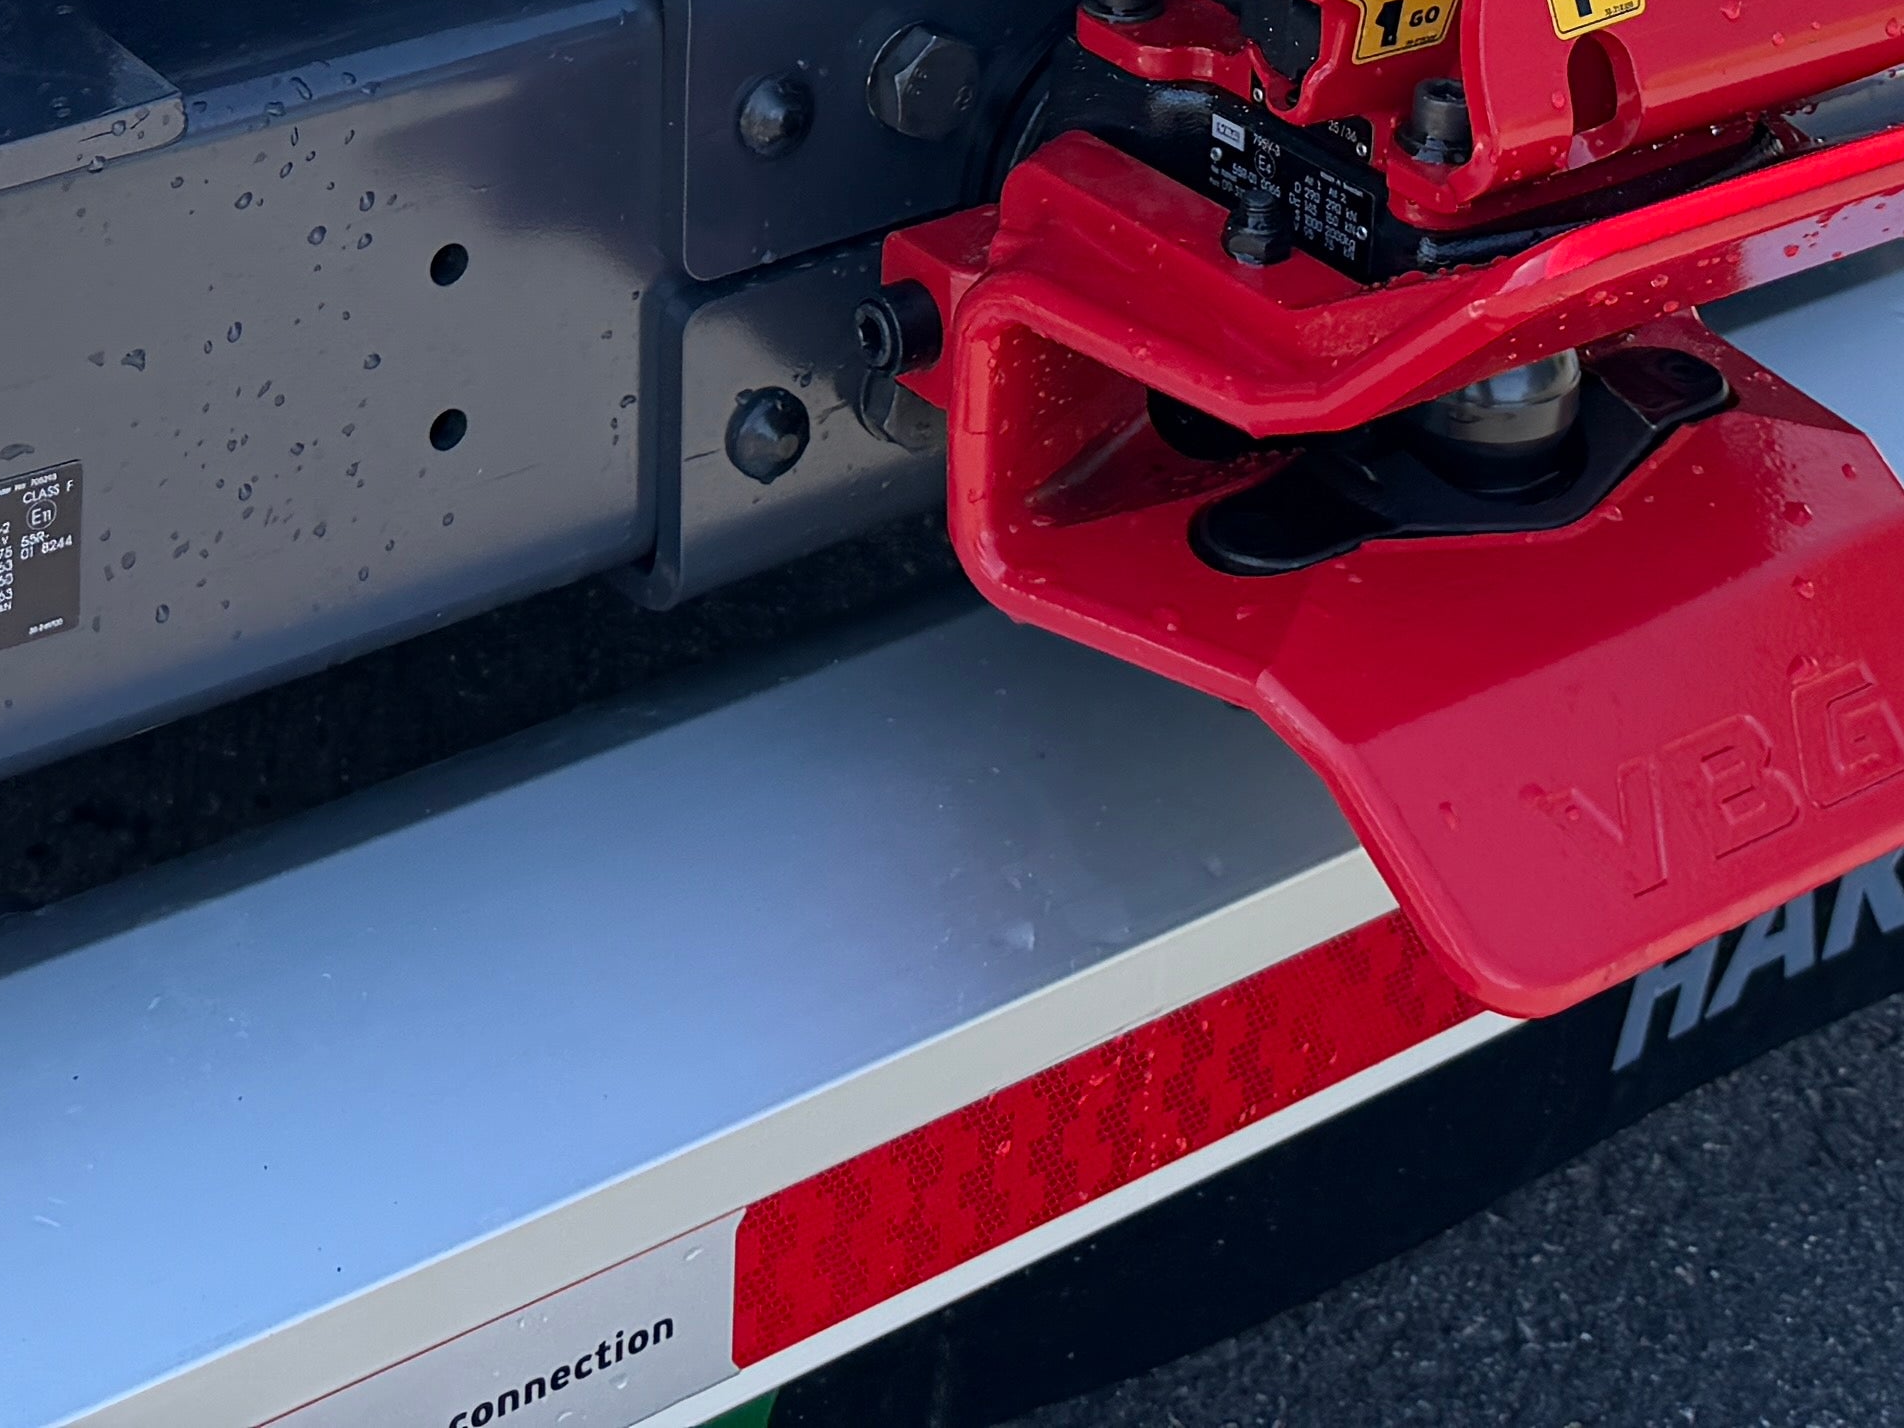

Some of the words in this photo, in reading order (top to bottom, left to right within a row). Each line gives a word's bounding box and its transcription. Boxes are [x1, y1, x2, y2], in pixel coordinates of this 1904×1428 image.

[1408, 5, 1441, 27] GO
[22, 483, 60, 504] CLASS
[41, 534, 73, 554] 8244
[449, 1317, 674, 1428] connection
